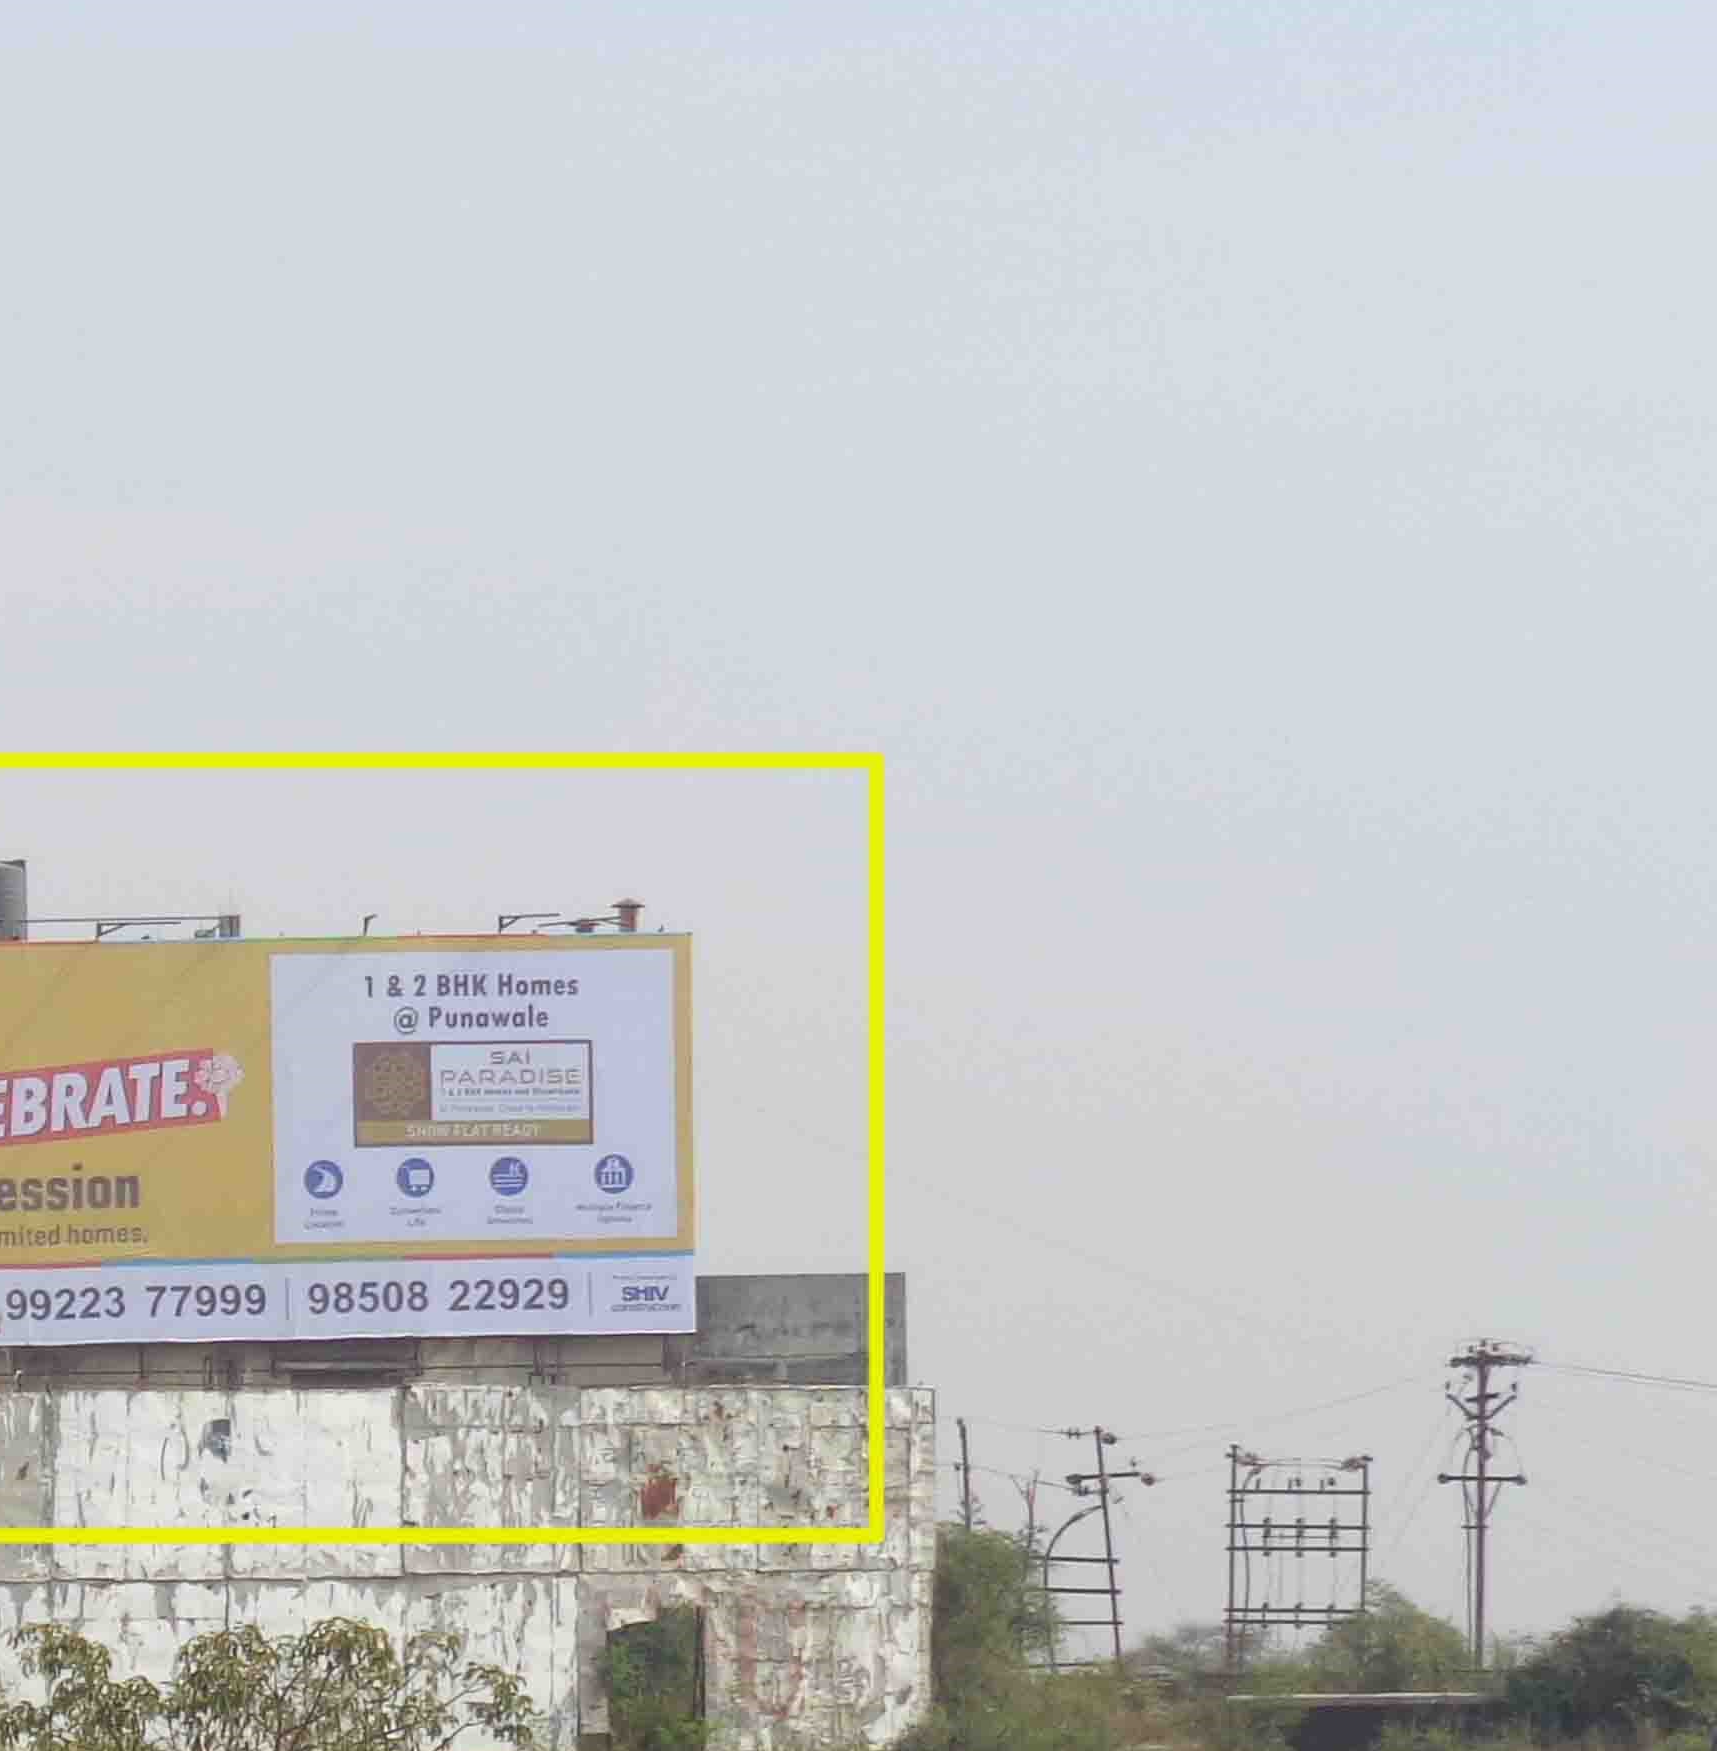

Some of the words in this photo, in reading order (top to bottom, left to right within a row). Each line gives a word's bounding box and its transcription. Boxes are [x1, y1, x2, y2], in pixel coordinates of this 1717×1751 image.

[365, 976, 374, 997] 1
[387, 975, 404, 997] &
[414, 975, 427, 996] 2
[437, 974, 487, 996] BHK
[498, 973, 579, 997] Homes
[394, 1006, 420, 1035] @
[429, 1003, 549, 1029] Punawale
[440, 1068, 582, 1085] PARADISE
[68, 1223, 149, 1246] homes.
[6, 1286, 126, 1320] 99223
[145, 1284, 266, 1317] 77999
[308, 1281, 429, 1315] 98508
[448, 1278, 570, 1311] 22929
